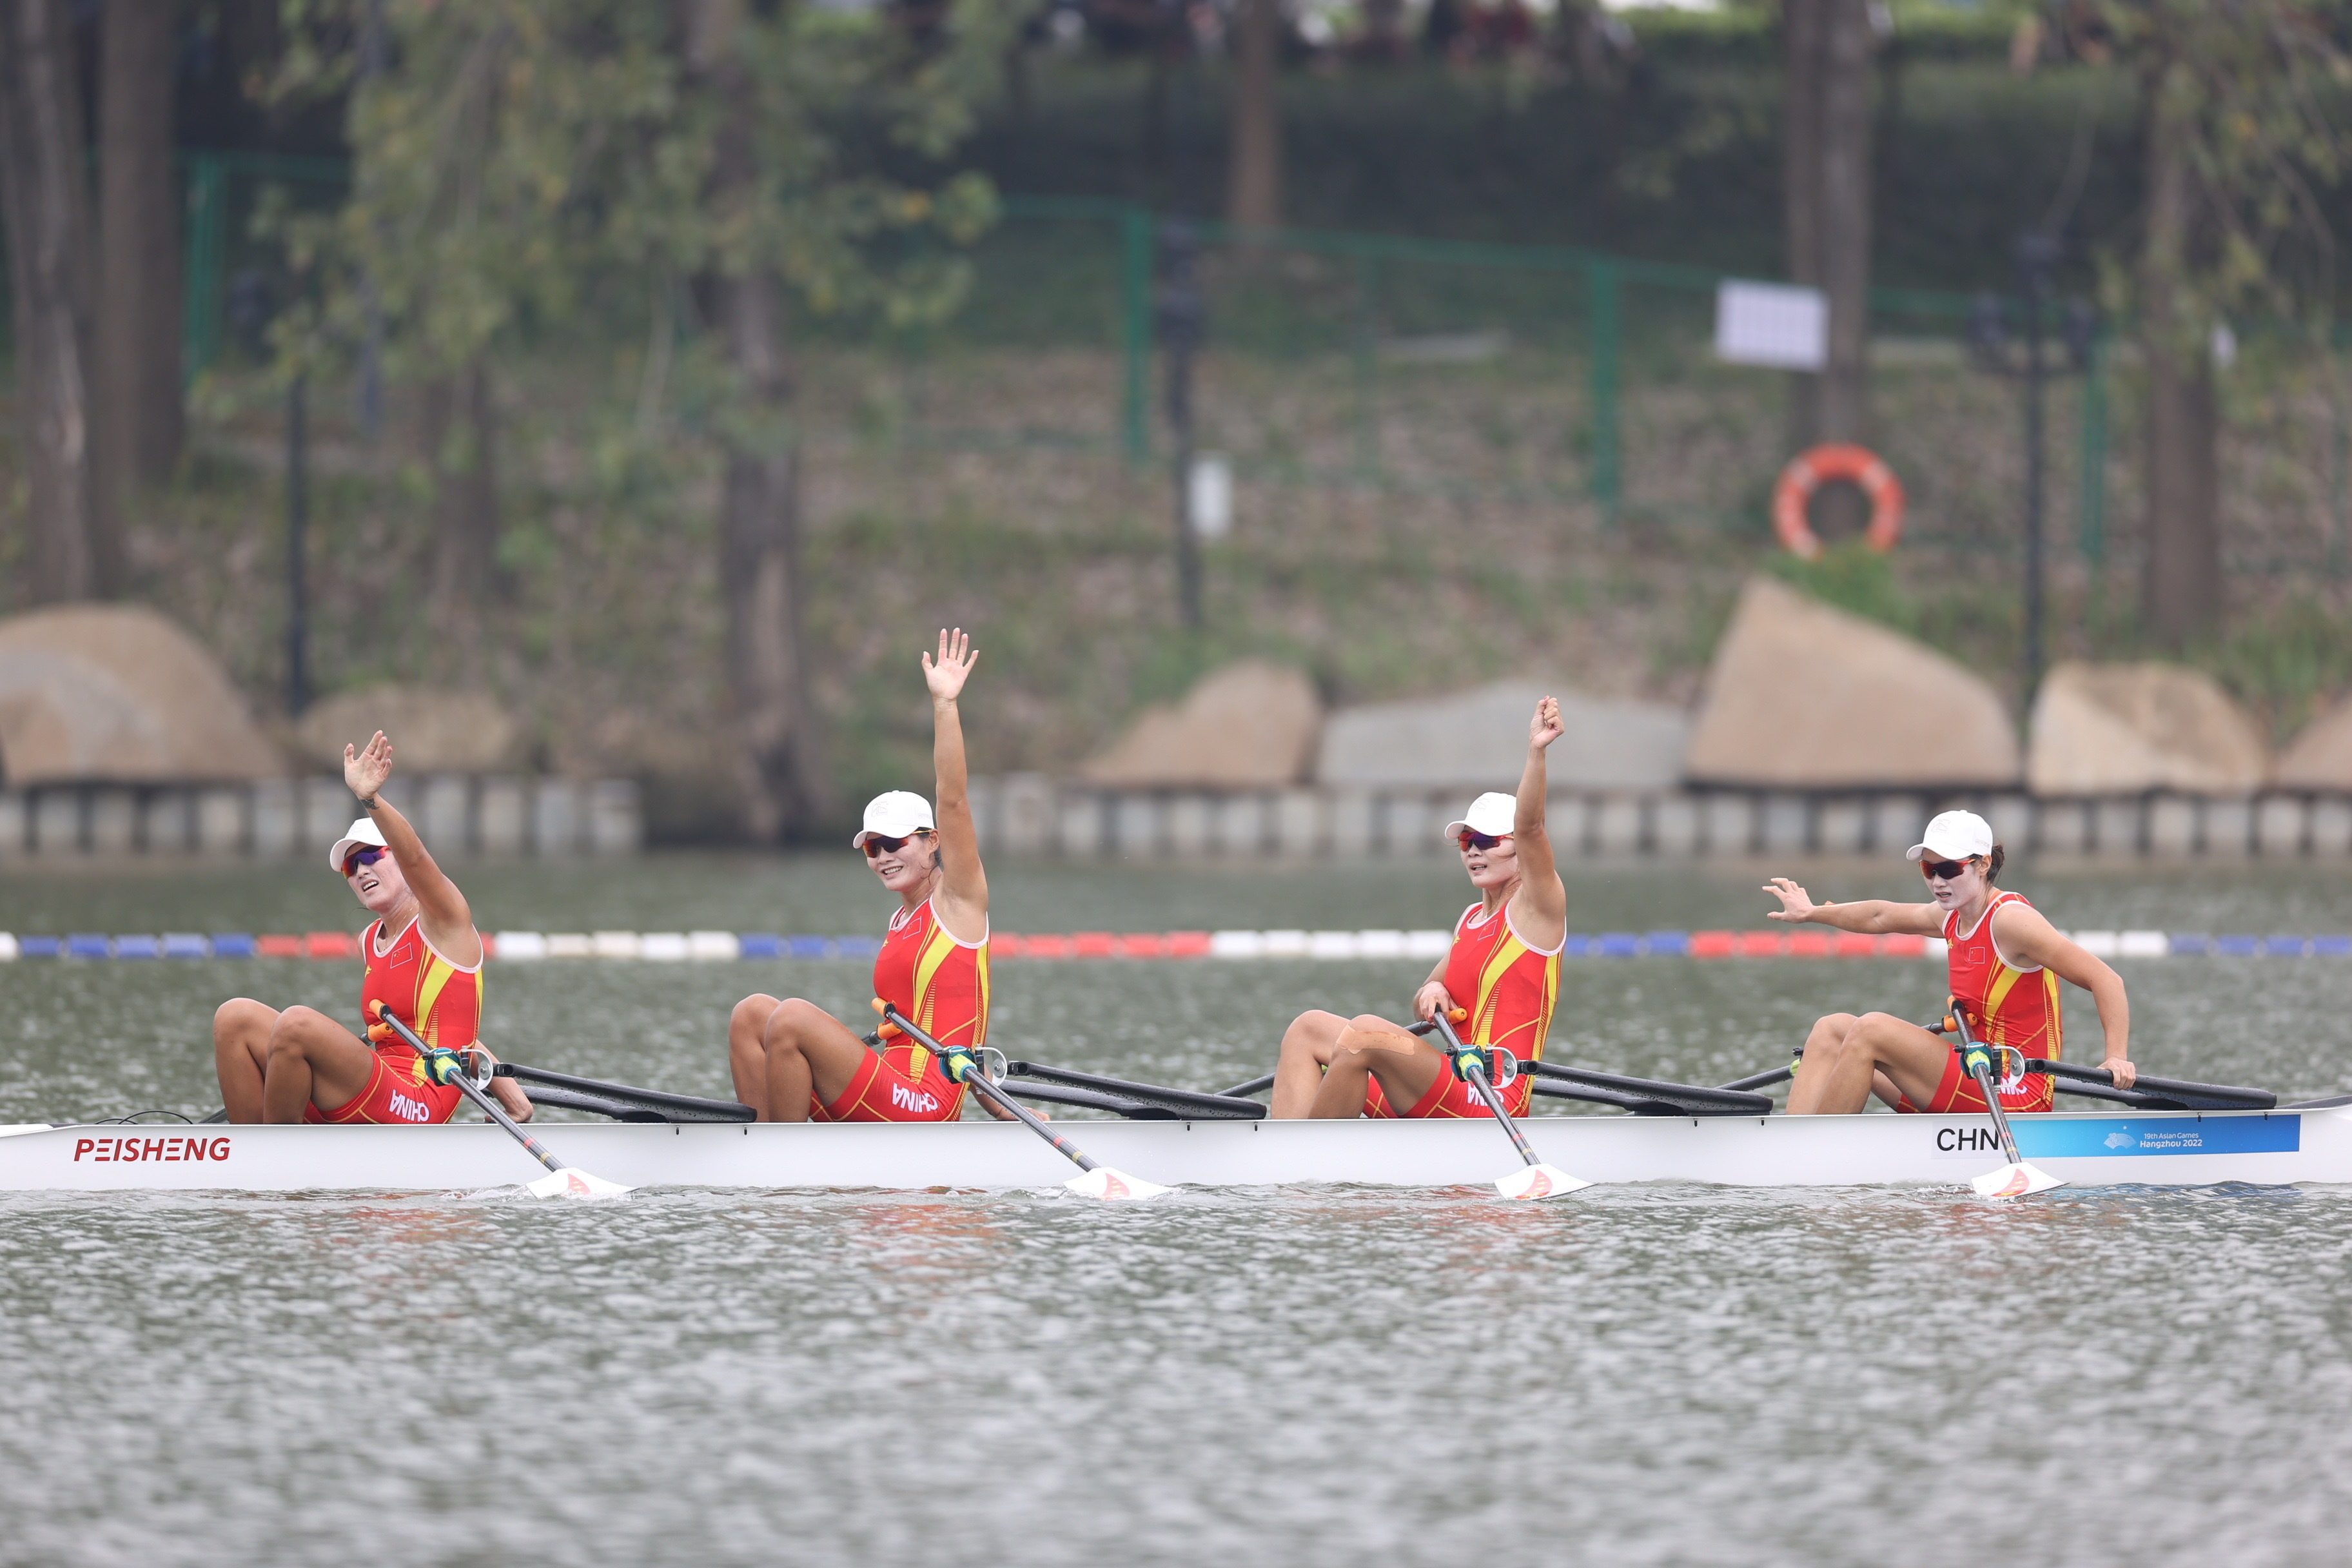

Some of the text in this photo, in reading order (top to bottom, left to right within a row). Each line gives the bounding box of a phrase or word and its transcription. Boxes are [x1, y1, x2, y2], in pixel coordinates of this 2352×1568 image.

[389, 1089, 430, 1122] CHINA
[892, 1083, 938, 1113] CHINA
[74, 1137, 231, 1162] PEISHENG
[1937, 1128, 1999, 1151] CHN
[2140, 1140, 2181, 1149] Hangzhou
